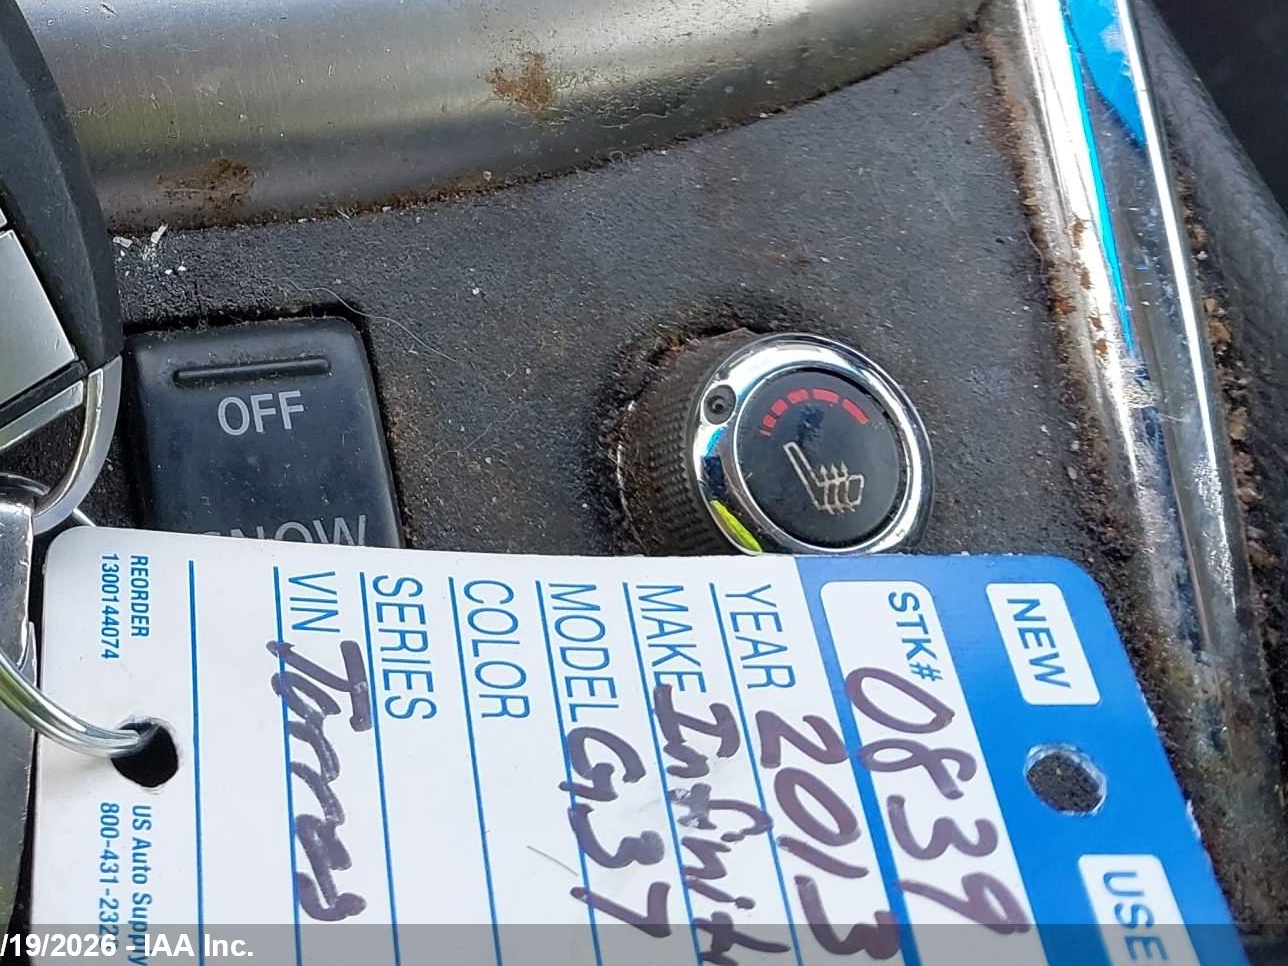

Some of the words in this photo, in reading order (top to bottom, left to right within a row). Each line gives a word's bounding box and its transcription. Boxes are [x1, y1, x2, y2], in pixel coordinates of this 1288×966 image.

[217, 390, 305, 436] OFF
[100, 553, 120, 659] 1300144074
[130, 554, 150, 637] REORDER
[286, 570, 342, 634] VIN
[370, 574, 439, 721] SERIES
[635, 584, 708, 695] MAKE
[724, 583, 797, 691] YEAR
[886, 589, 944, 684] STK#
[1007, 597, 1074, 690] NEW
[462, 579, 532, 720] COLOR
[548, 583, 621, 724] MODEL
[131, 804, 153, 831] US
[558, 726, 673, 938] G37
[652, 684, 791, 966] Infinit
[755, 708, 902, 961] 2013
[845, 665, 1032, 936] 0839
[131, 837, 153, 885] Auto
[127, 892, 153, 966] Supply
[1103, 871, 1170, 966] USE
